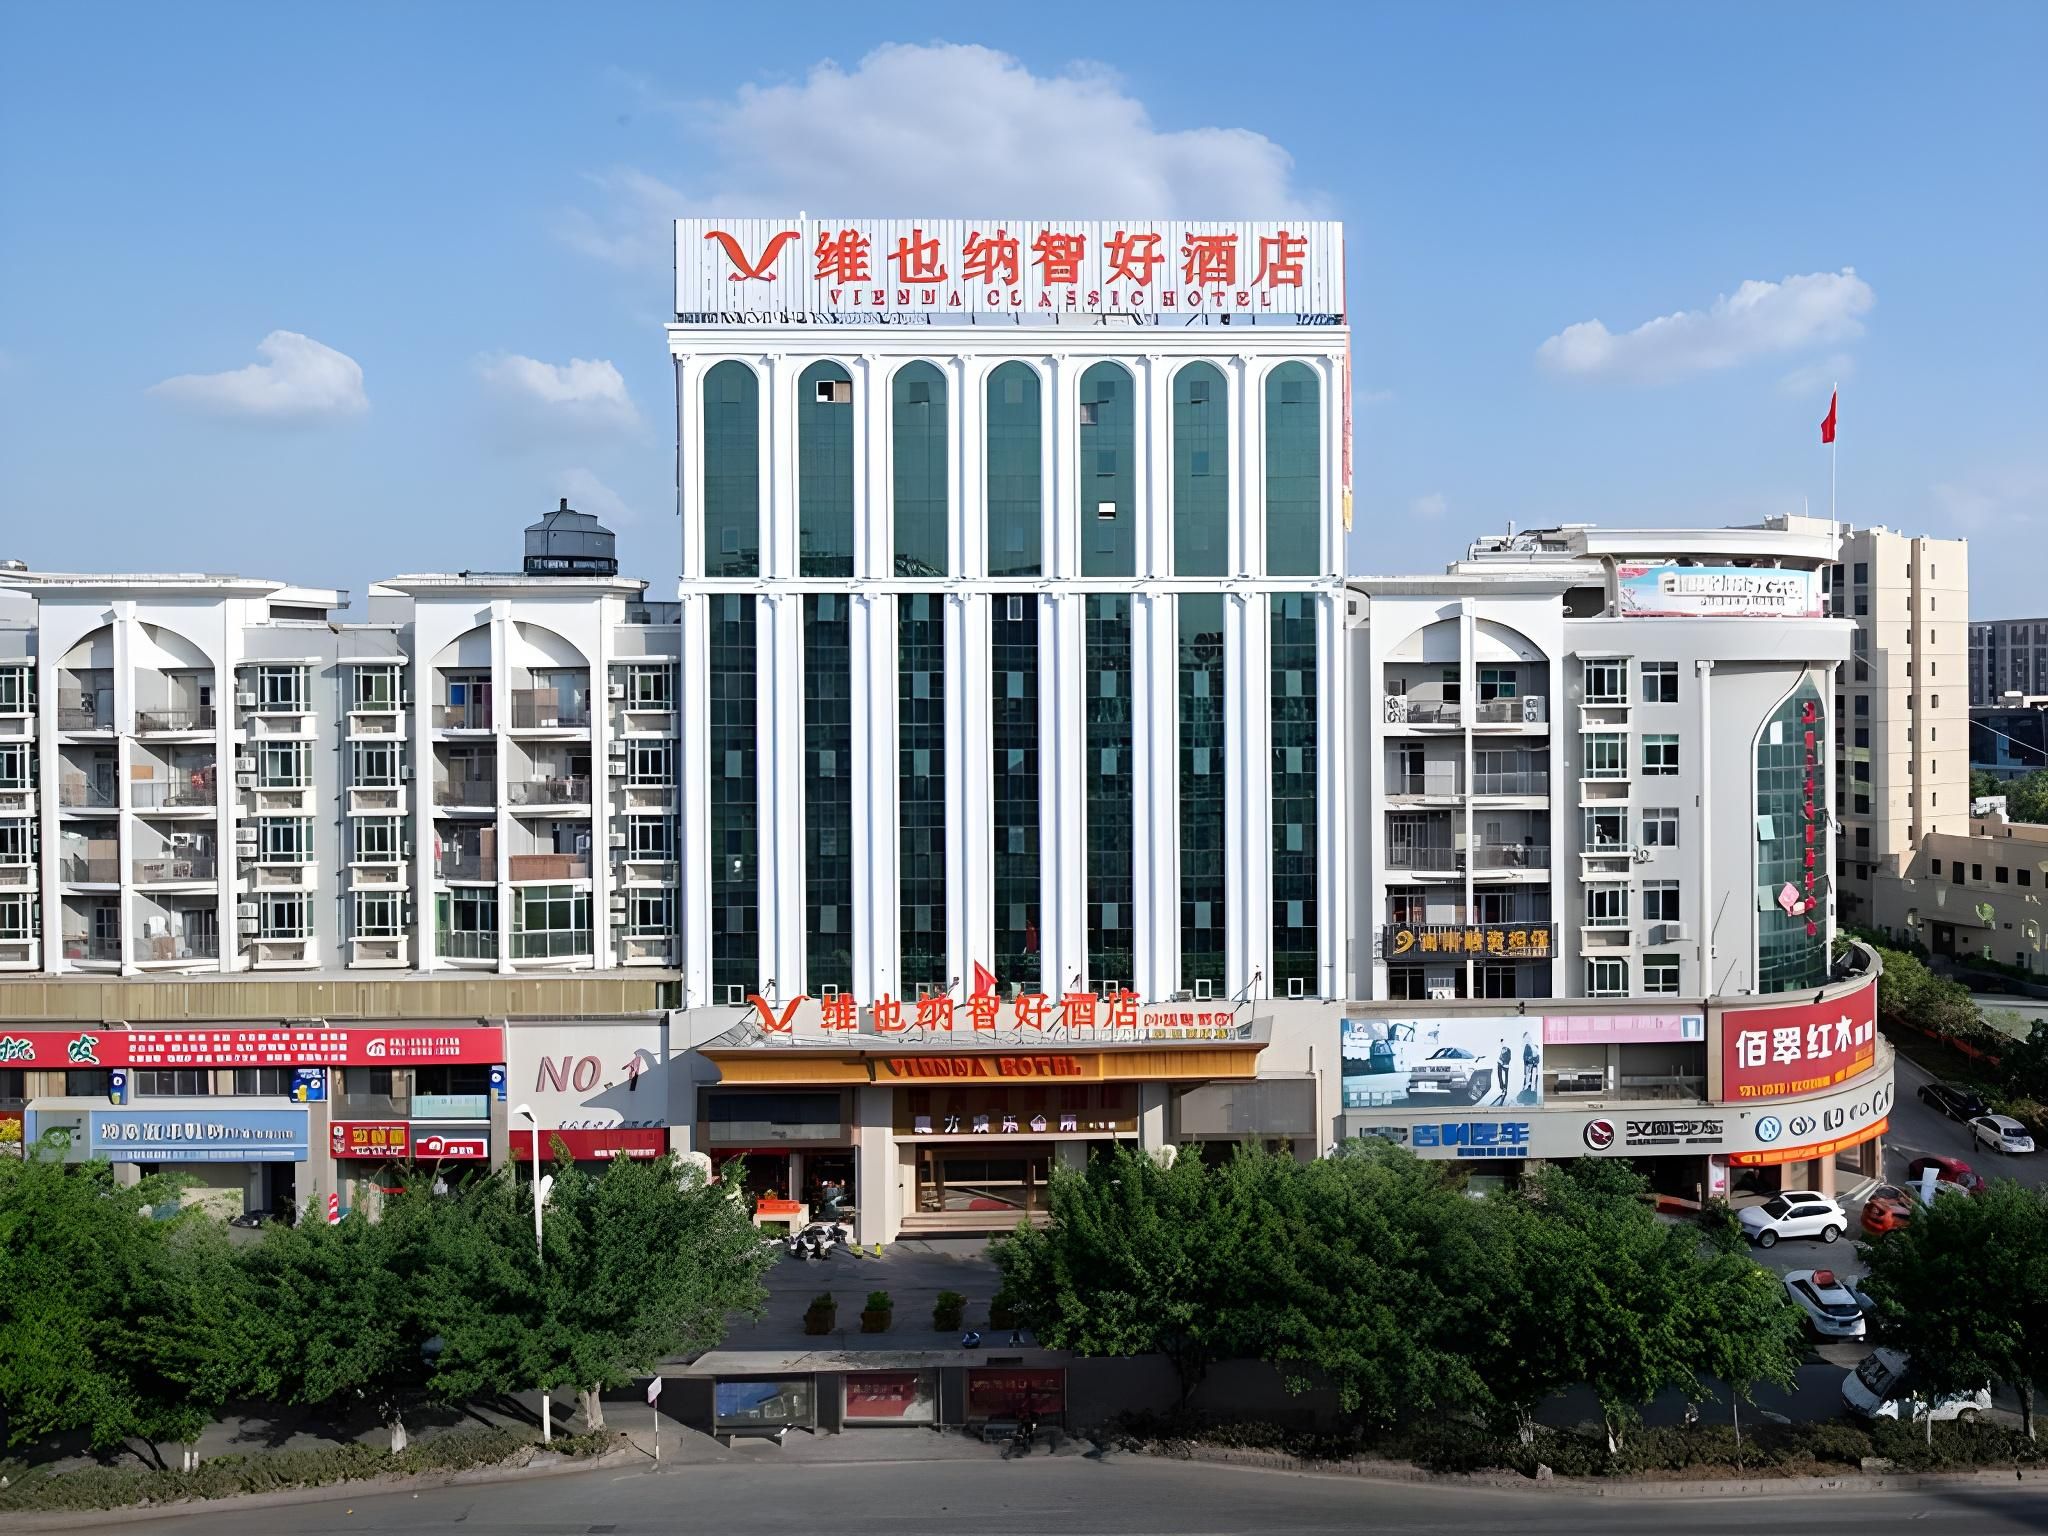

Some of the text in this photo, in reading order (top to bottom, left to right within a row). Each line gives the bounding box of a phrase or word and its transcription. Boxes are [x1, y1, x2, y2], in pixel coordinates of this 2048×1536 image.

[814, 228, 1307, 288] 维也纳智好酒店
[821, 988, 1141, 1031] 维也纳智好酒店
[1735, 1015, 1873, 1069] 佰翠红木
